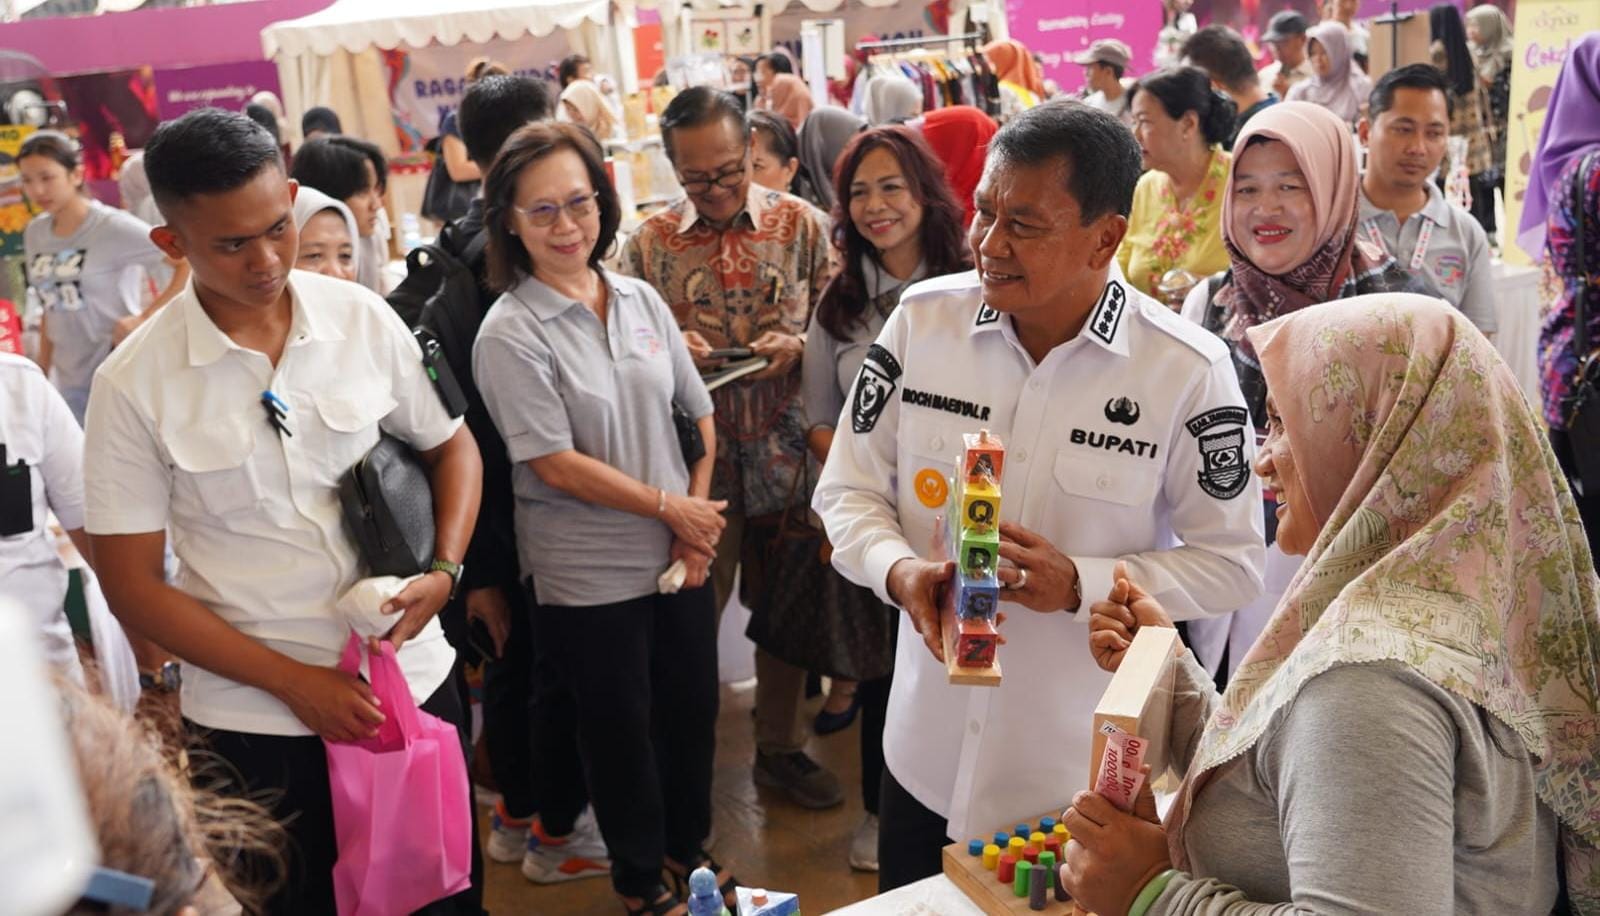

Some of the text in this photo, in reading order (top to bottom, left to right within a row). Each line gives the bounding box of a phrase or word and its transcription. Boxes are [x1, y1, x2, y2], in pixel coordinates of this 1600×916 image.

[1070, 428, 1158, 459] BUPATI
[970, 453, 995, 476] A
[968, 499, 994, 525] Q
[966, 546, 991, 570] D
[969, 592, 993, 616] G
[966, 639, 991, 662] Z
